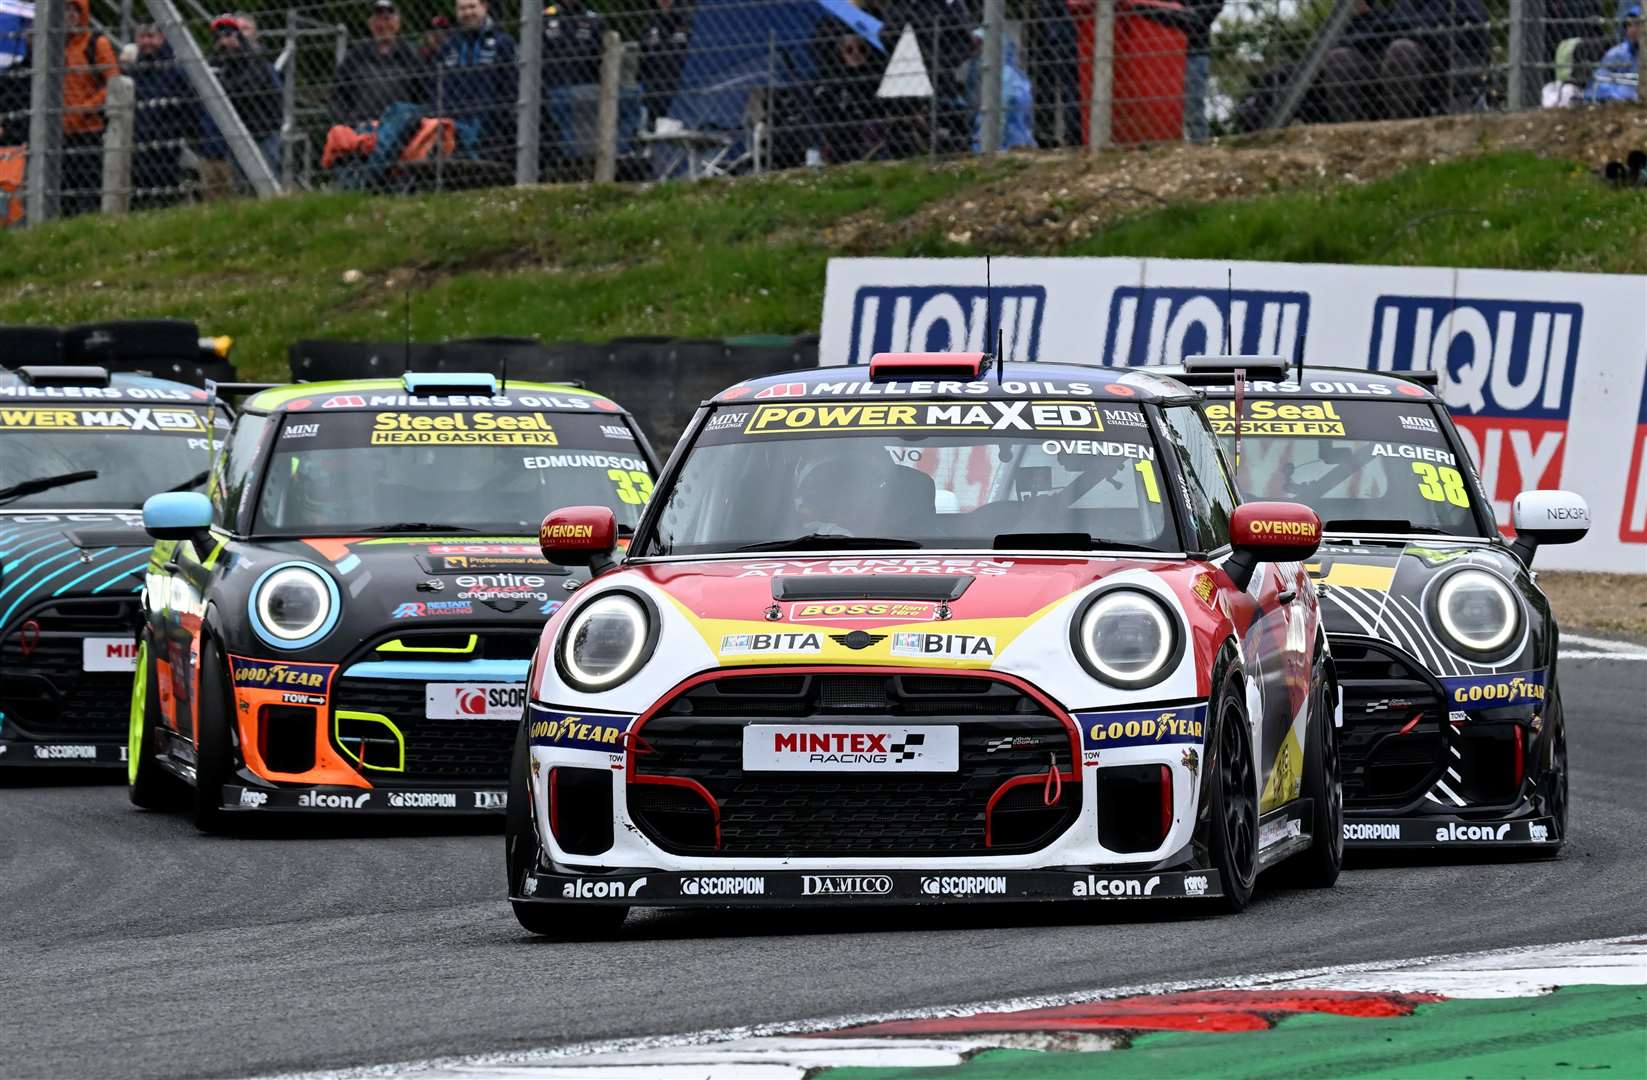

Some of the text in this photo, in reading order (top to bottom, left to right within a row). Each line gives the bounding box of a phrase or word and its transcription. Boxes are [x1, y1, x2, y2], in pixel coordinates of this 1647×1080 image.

[127, 387, 191, 399] OILS
[812, 381, 1093, 395] MILLERS OILS
[1310, 381, 1392, 395] OILS
[370, 395, 590, 408] MILLERS OILS
[711, 412, 748, 424] MINI
[755, 406, 917, 428] POWER
[1104, 409, 1146, 421] MINI
[1250, 401, 1341, 420] Seal
[81, 407, 197, 431] MAXED
[374, 412, 551, 431] Steel Seal
[1398, 415, 1436, 428] MINI
[284, 423, 320, 435] MINI
[1304, 424, 1340, 434] FIX
[376, 432, 553, 444] HEAD GASKET FIX
[1042, 440, 1155, 460] OVENDEN
[1372, 444, 1455, 466] ALGIERI
[524, 456, 649, 472] EDMUNDSON
[607, 469, 654, 505] 33
[1134, 459, 1161, 504] 1
[1412, 461, 1470, 509] 38
[541, 525, 593, 538] OVENDEN
[1249, 520, 1316, 536] OVENDEN
[735, 566, 1008, 578] ALLWORKS
[456, 573, 546, 588] entire
[457, 590, 549, 601] engineering
[800, 604, 889, 616] BOSS
[752, 633, 820, 650] BITA
[924, 634, 993, 655] BITA
[283, 694, 308, 703] TOW
[775, 733, 888, 752] MINTEX
[50, 746, 96, 758] SCORPION
[609, 754, 624, 762] TOW
[809, 754, 887, 763] RACING
[1084, 752, 1100, 760] TOW
[298, 791, 354, 808] alcon
[404, 793, 456, 807] SCORPION
[1343, 824, 1400, 840] SCORPION
[1436, 823, 1495, 841] alcon
[562, 878, 625, 898] alcon
[700, 877, 764, 894] SCORPION
[801, 876, 893, 895] DAMICO
[941, 877, 1007, 894] SCORPION
[1072, 875, 1141, 896] alcon
